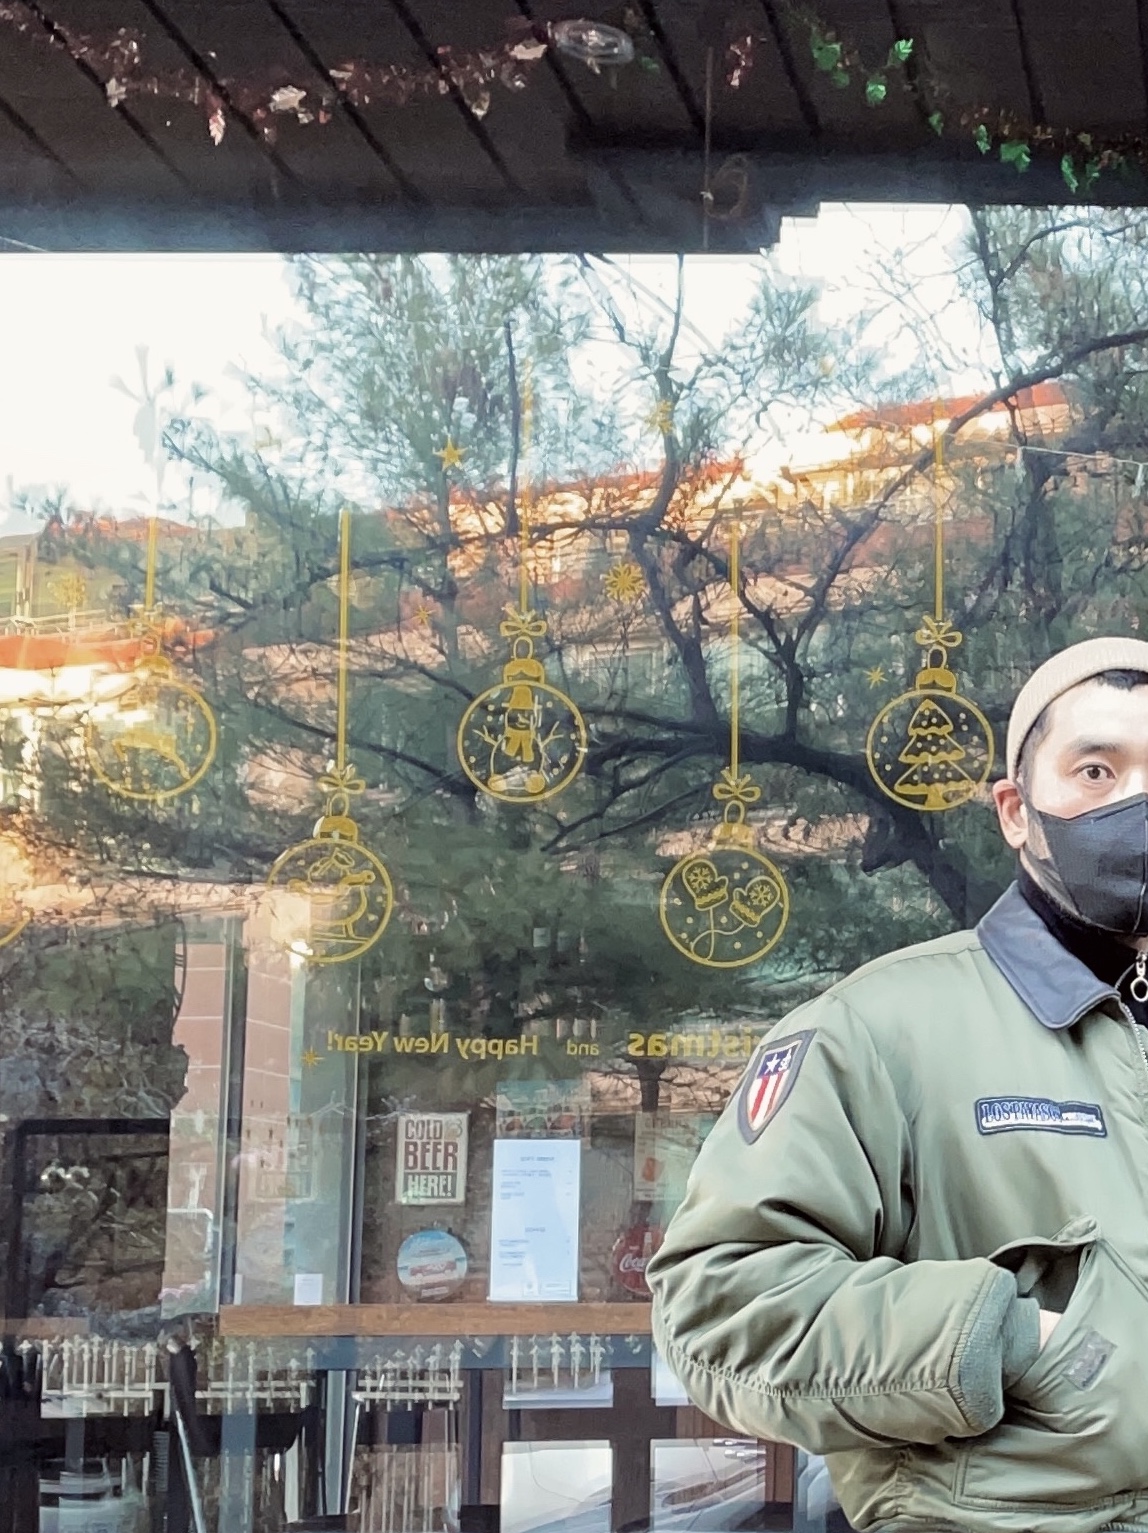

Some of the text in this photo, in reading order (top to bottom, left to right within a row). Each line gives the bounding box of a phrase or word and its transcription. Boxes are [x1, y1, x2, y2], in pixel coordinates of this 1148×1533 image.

[405, 1120, 443, 1140] COLD
[404, 1141, 459, 1170] BEER
[407, 1174, 453, 1197] HERE!
